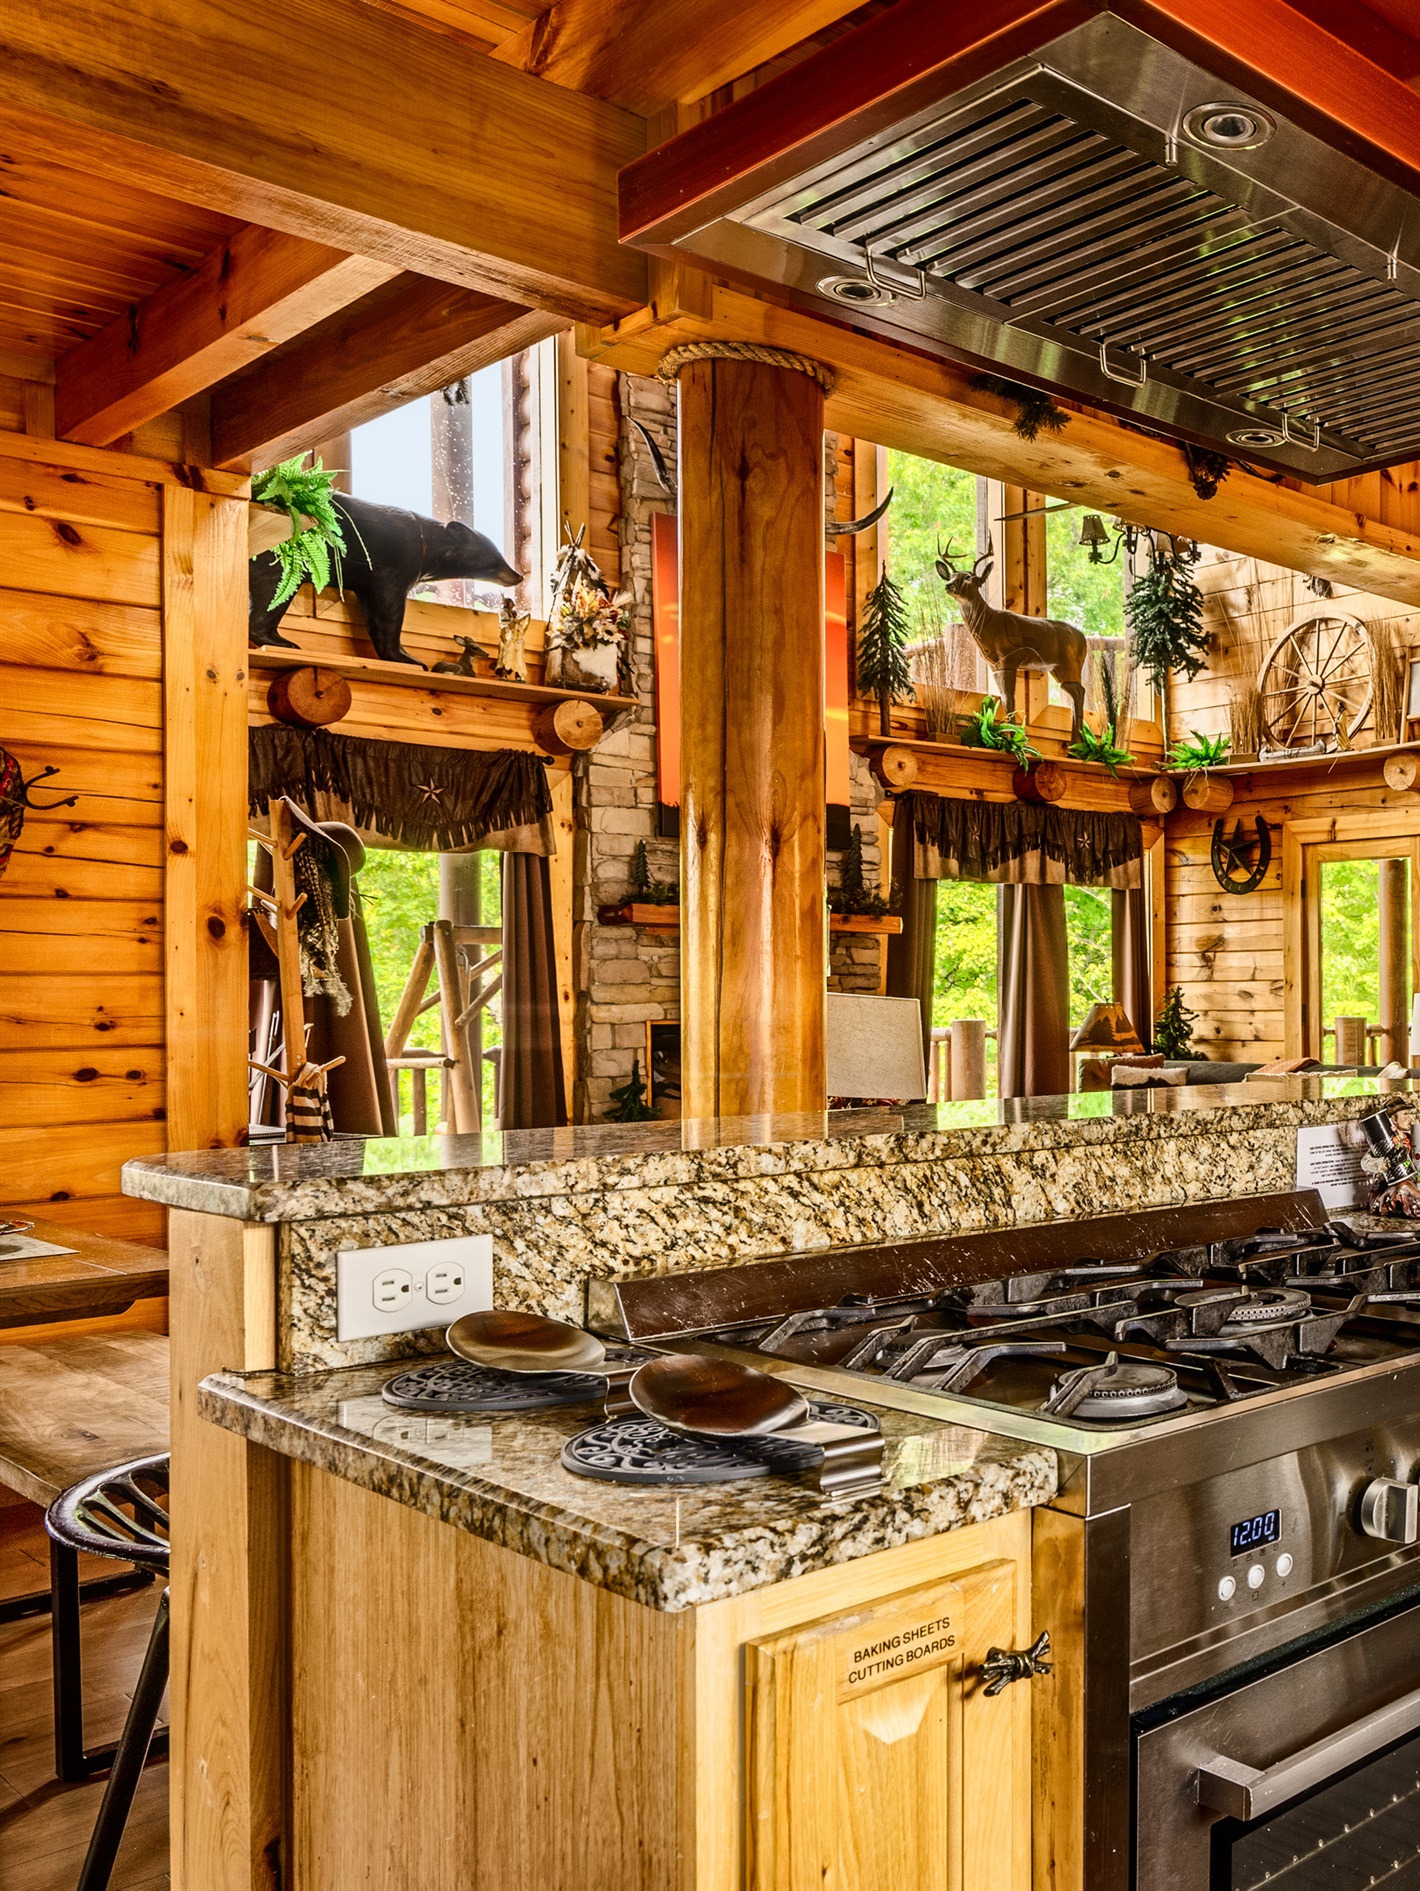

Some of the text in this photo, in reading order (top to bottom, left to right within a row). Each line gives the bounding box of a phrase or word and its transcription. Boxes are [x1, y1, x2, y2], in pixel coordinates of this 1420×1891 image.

[848, 1634, 955, 1684] CUTTING BOARDS
[854, 1617, 951, 1663] BAKING SHEETS
